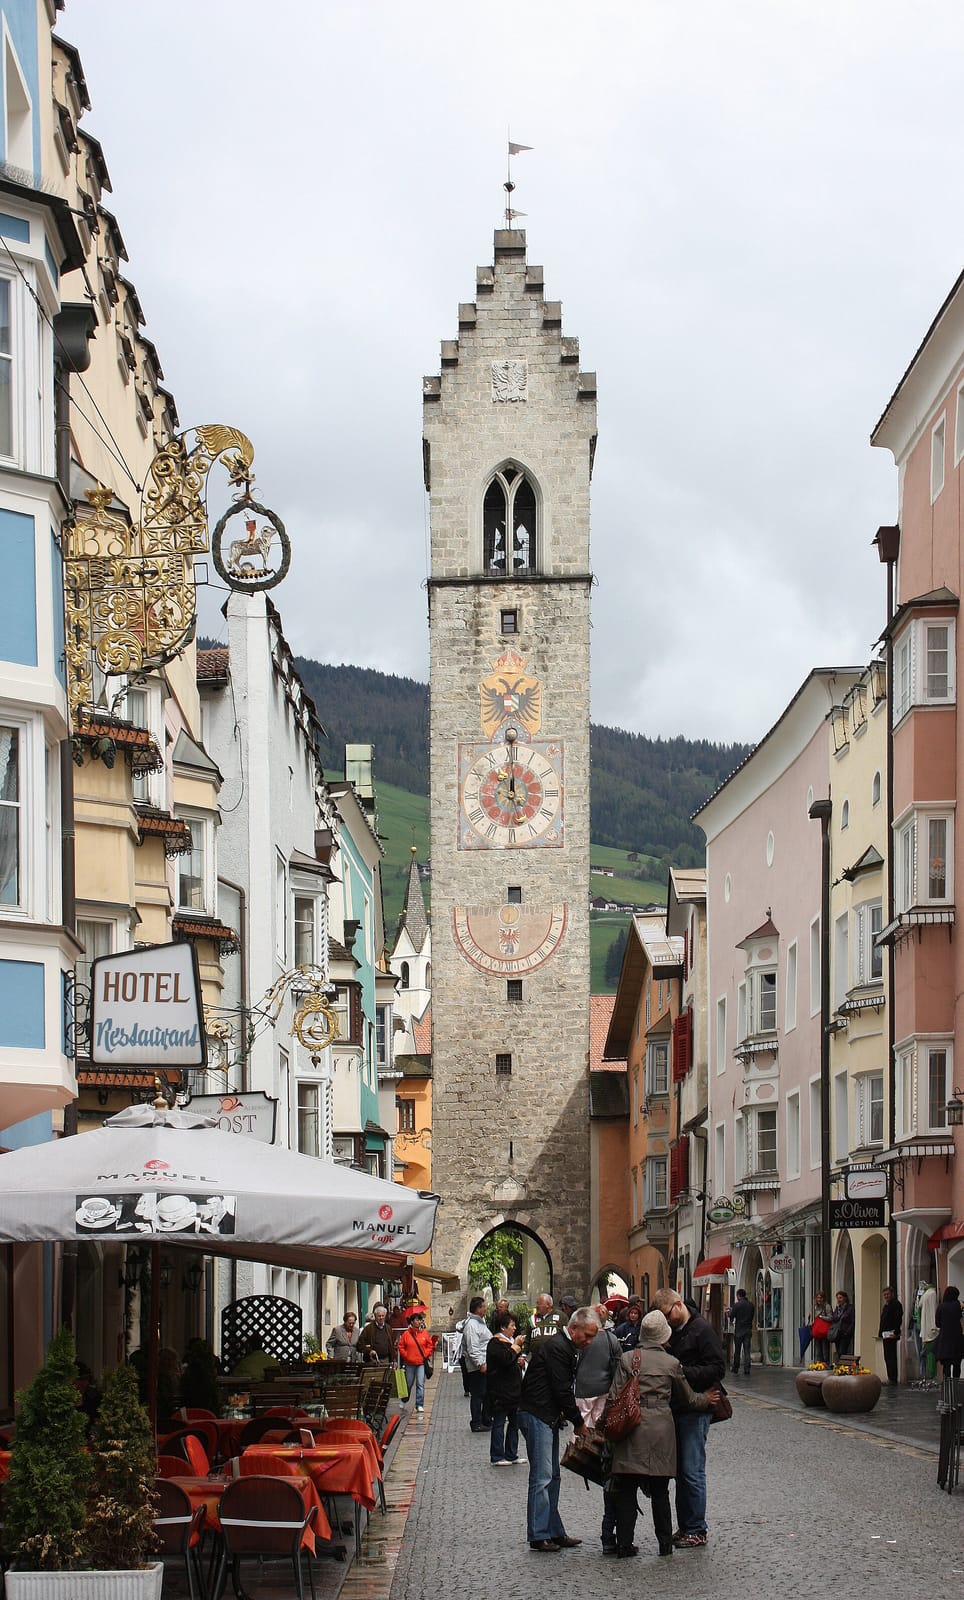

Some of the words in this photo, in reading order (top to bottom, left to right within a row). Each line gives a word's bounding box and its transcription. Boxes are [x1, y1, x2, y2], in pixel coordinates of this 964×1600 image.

[527, 752, 535, 768] I
[540, 768, 553, 778] II
[545, 789, 558, 798] III
[103, 971, 190, 1003] HOTEL
[96, 1018, 200, 1054] Restaurant
[97, 1170, 219, 1183] MANUEL
[834, 1201, 879, 1219] s.Oliver
[352, 1220, 416, 1235] MANUEL
[531, 1326, 557, 1339] ITALIA
